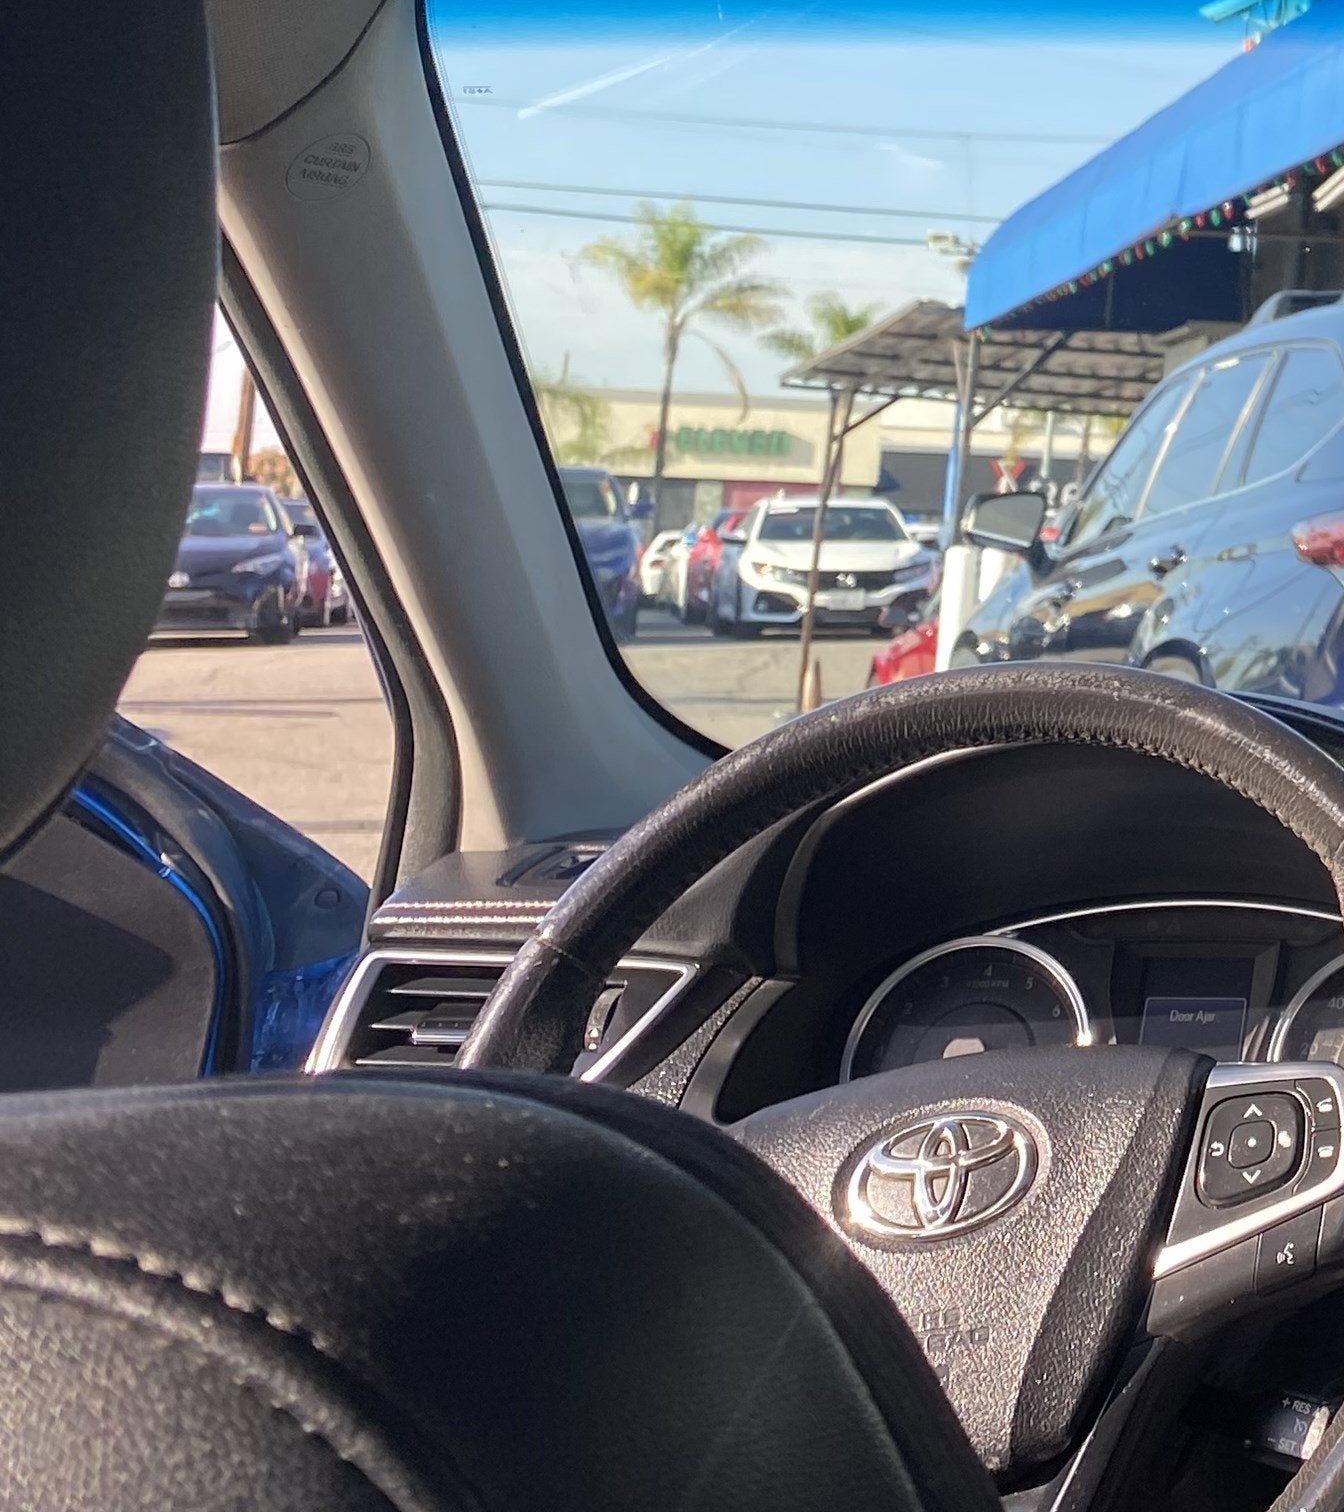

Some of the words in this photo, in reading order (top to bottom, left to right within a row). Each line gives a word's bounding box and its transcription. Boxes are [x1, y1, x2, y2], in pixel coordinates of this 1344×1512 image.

[1327, 997, 1344, 1010] 40
[1169, 1009, 1194, 1022] Door
[1195, 1010, 1217, 1025] Ajar
[1292, 1400, 1312, 1415] RES
[1278, 1438, 1298, 1451] SET
